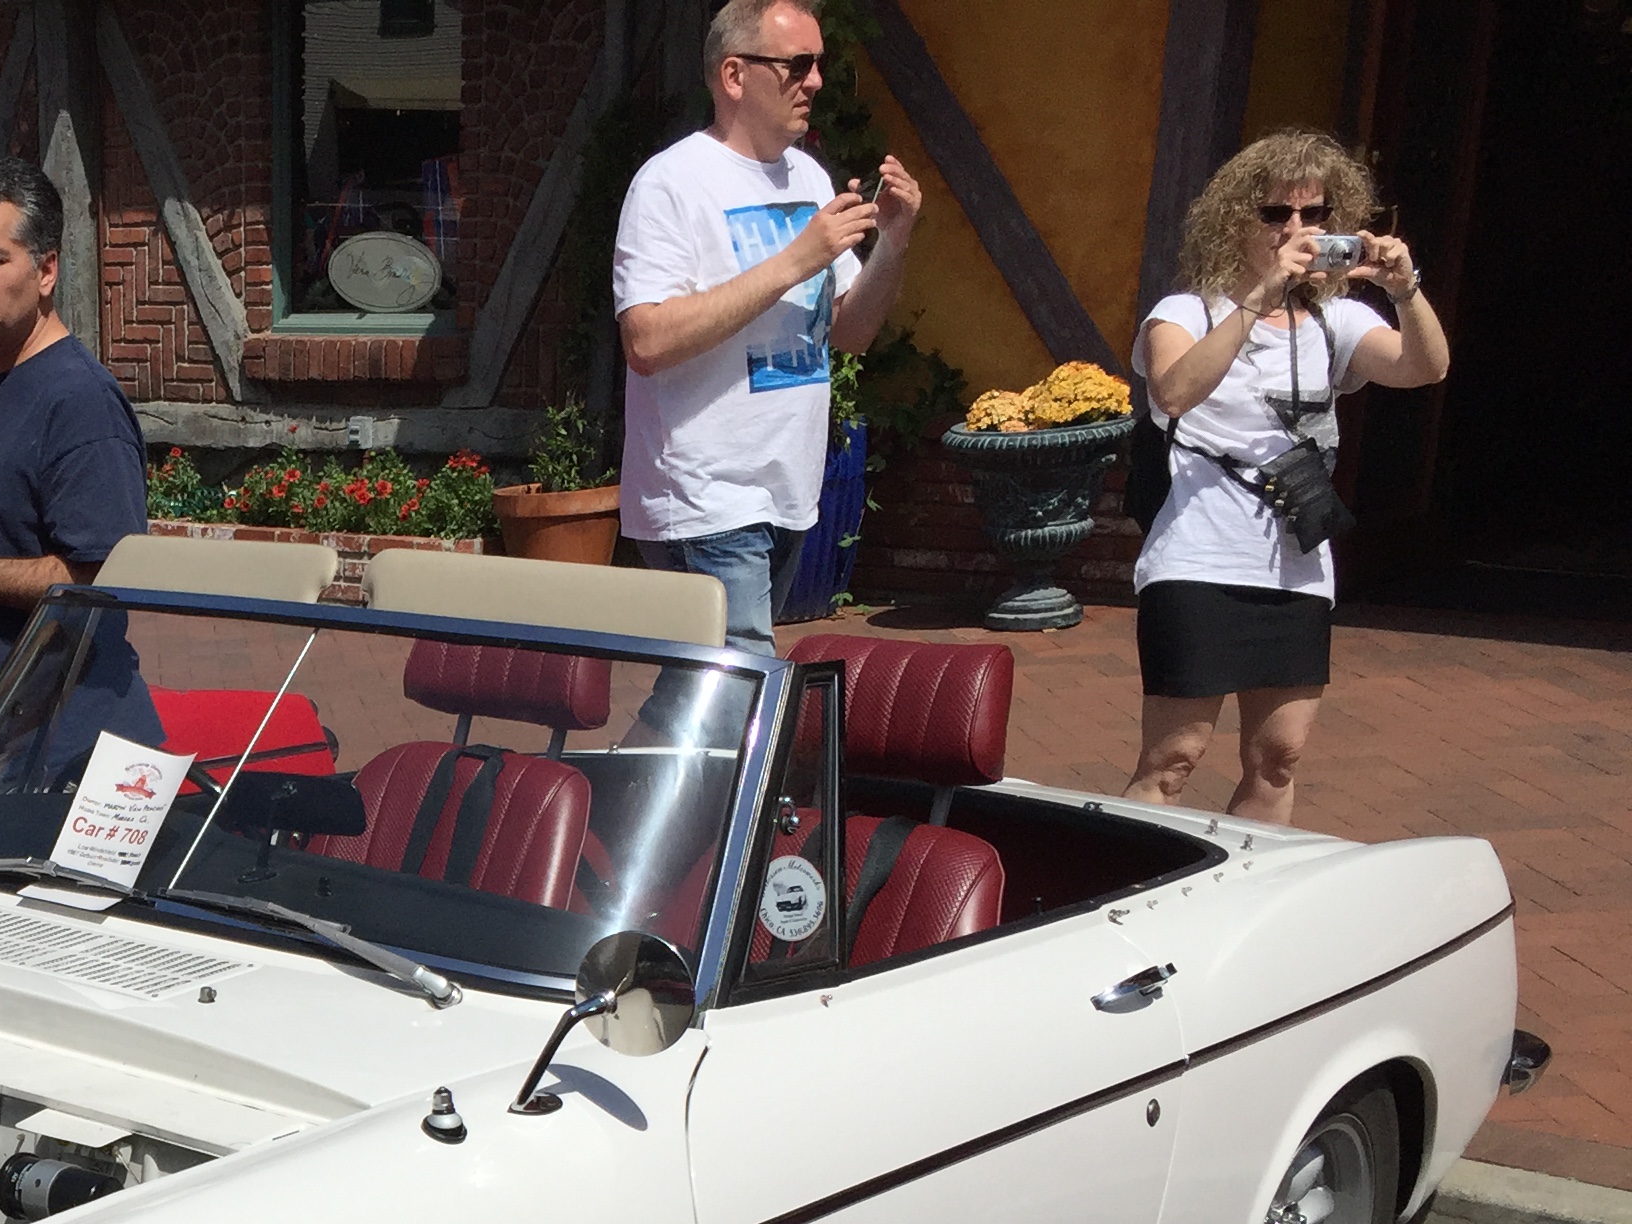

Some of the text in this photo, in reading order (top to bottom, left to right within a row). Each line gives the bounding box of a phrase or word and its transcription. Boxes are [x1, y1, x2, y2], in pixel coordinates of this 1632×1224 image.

[72, 816, 149, 846] Car # 708
